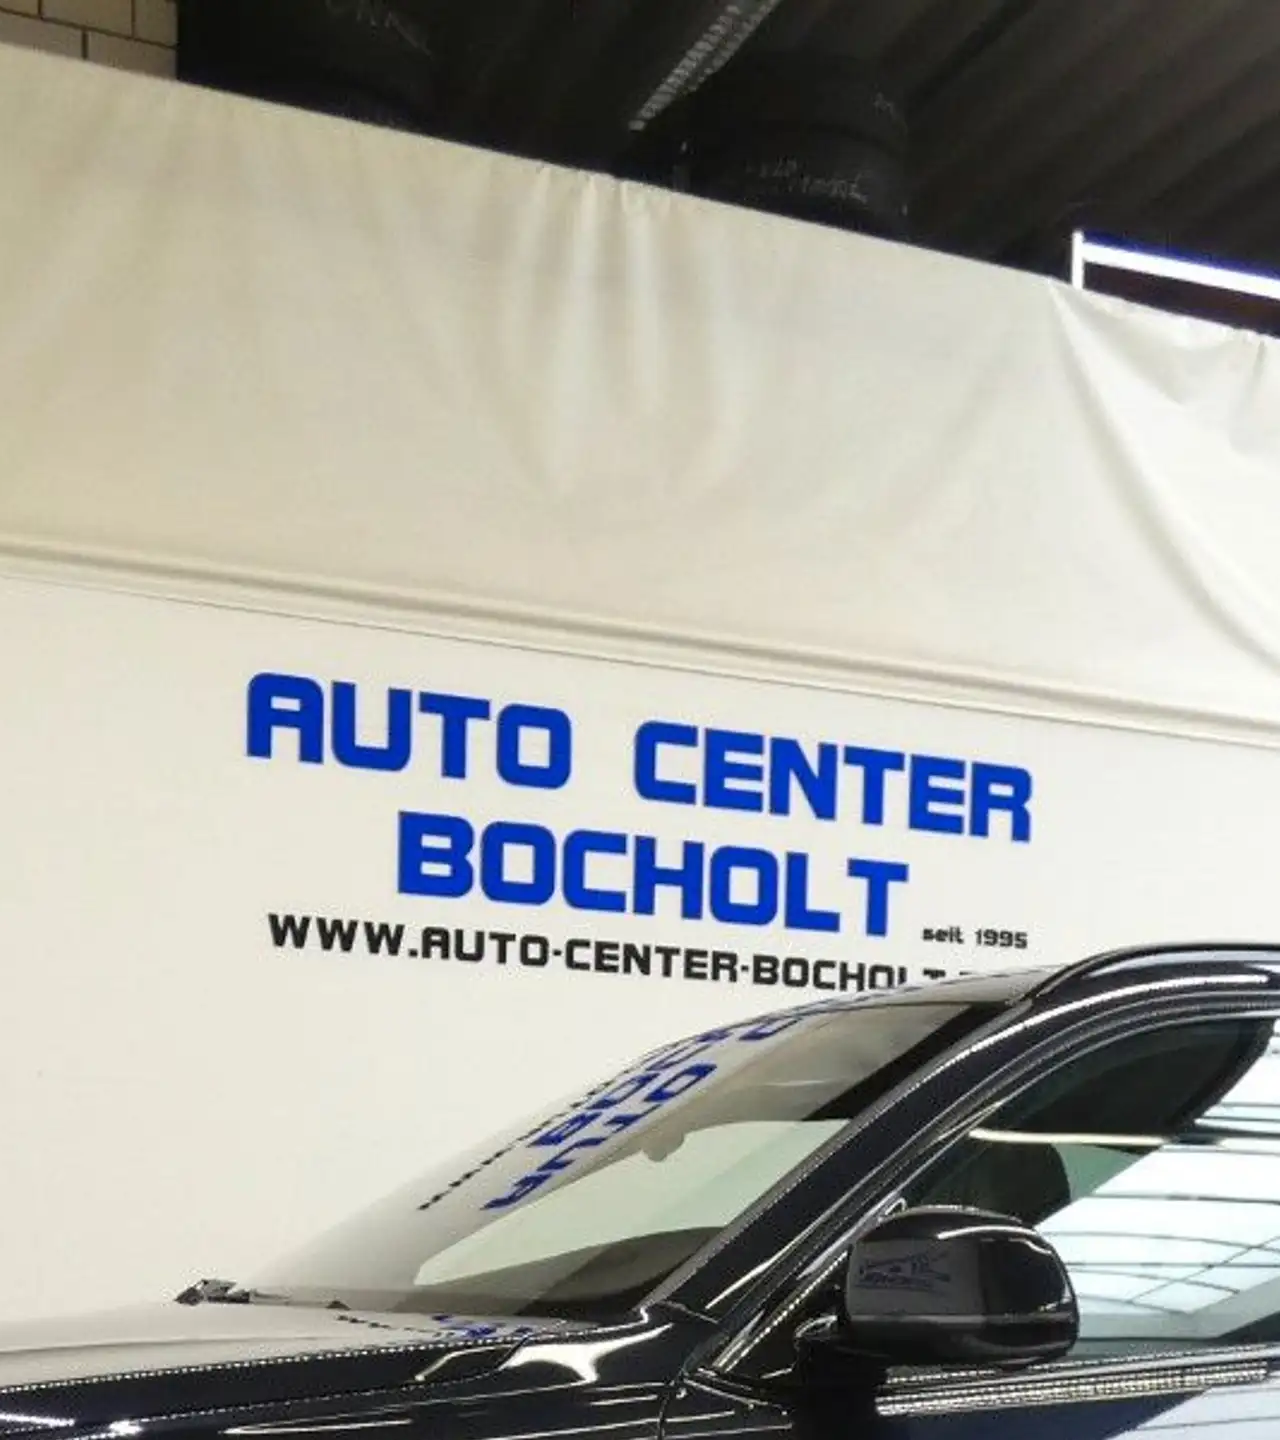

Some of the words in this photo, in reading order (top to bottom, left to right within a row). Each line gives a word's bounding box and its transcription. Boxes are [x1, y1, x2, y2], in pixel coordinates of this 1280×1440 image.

[246, 671, 573, 790] AUTO
[633, 719, 1034, 845] CENTER
[397, 810, 910, 938] BOCHOLT
[267, 912, 970, 993] WWW.AUTO-CENTER-BOCHO
[922, 926, 964, 945] seit
[974, 928, 1028, 949] 1995
